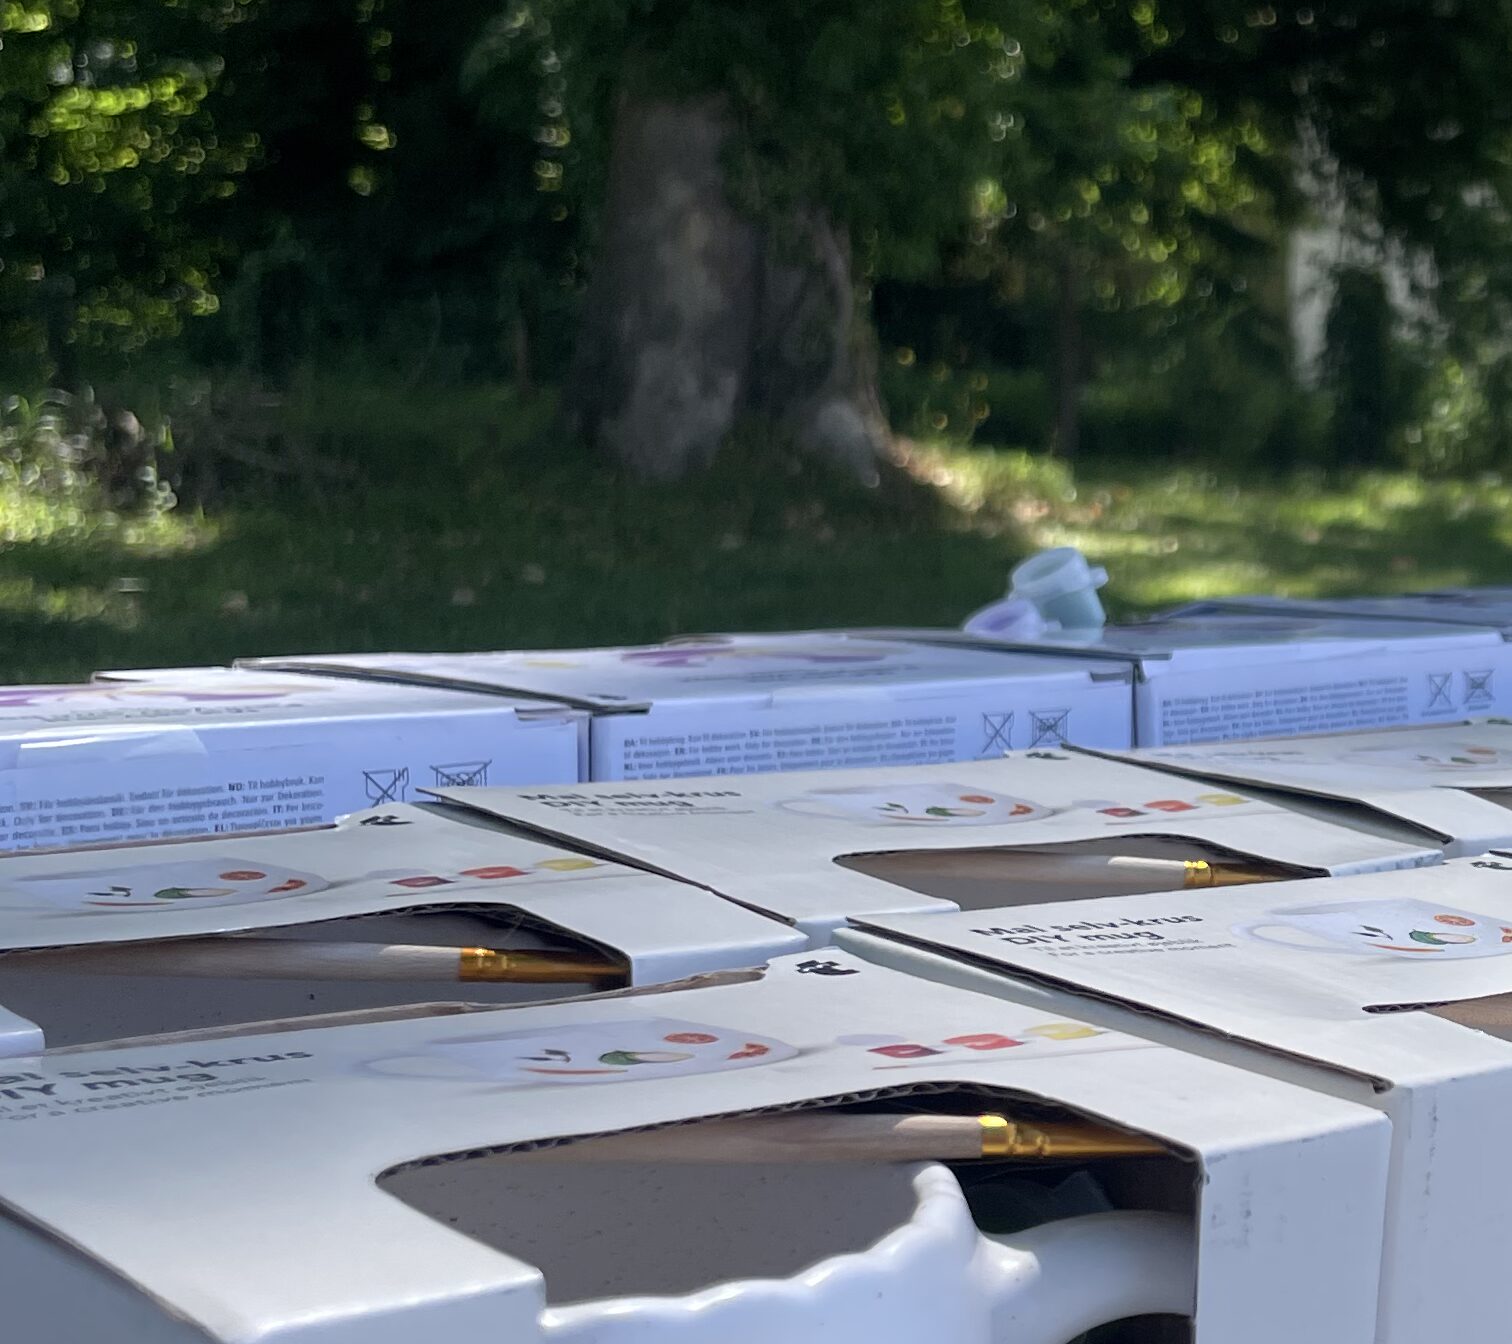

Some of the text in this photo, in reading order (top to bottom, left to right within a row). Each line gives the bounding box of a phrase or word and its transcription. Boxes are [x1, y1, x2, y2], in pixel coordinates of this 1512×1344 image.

[969, 915, 1203, 936] Mal selv-krus
[1001, 931, 1165, 945] DIY mug
[0, 1052, 313, 1085] al selv-krus
[0, 1073, 218, 1100] IY mug
[55, 1088, 169, 1106] kreativt
[0, 1113, 37, 1121] or
[74, 1095, 189, 1113] creative
